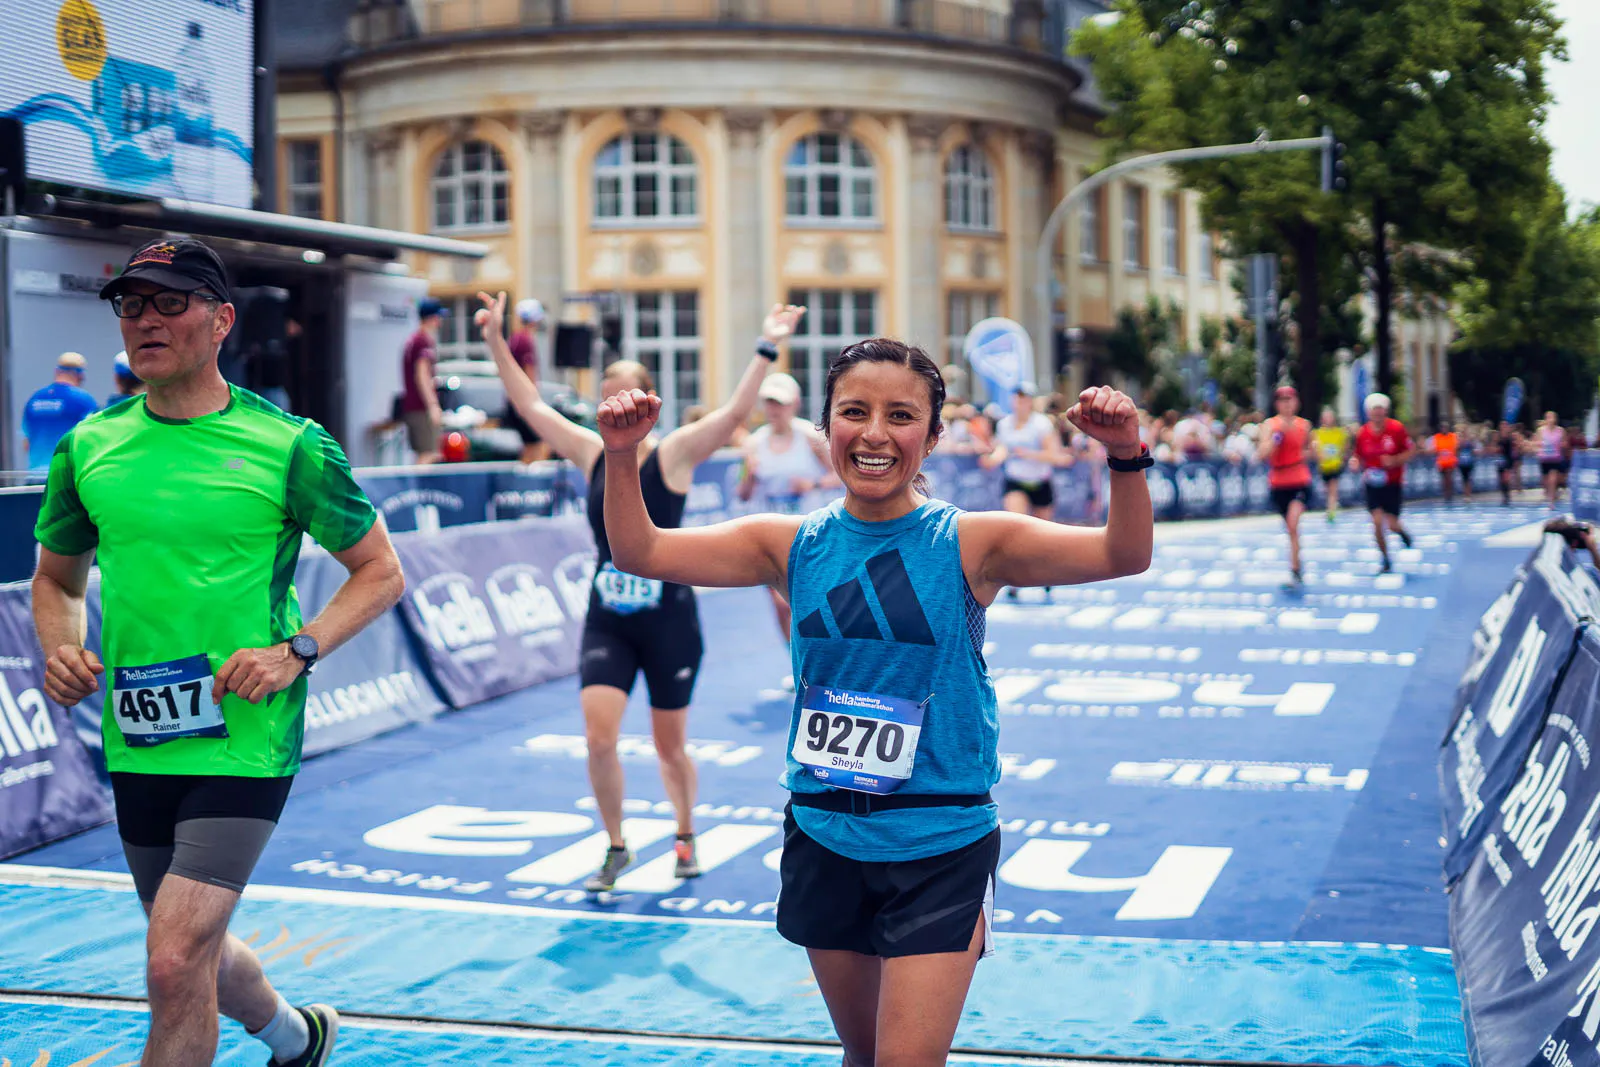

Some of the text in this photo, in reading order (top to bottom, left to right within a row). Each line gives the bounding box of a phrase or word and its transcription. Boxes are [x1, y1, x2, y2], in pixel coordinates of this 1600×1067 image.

[120, 681, 202, 723] 4617
[828, 691, 854, 706] hella
[854, 695, 881, 705] hamburg
[152, 723, 181, 732] Rainer
[807, 712, 904, 763] 9270
[831, 756, 864, 771] Sheyla
